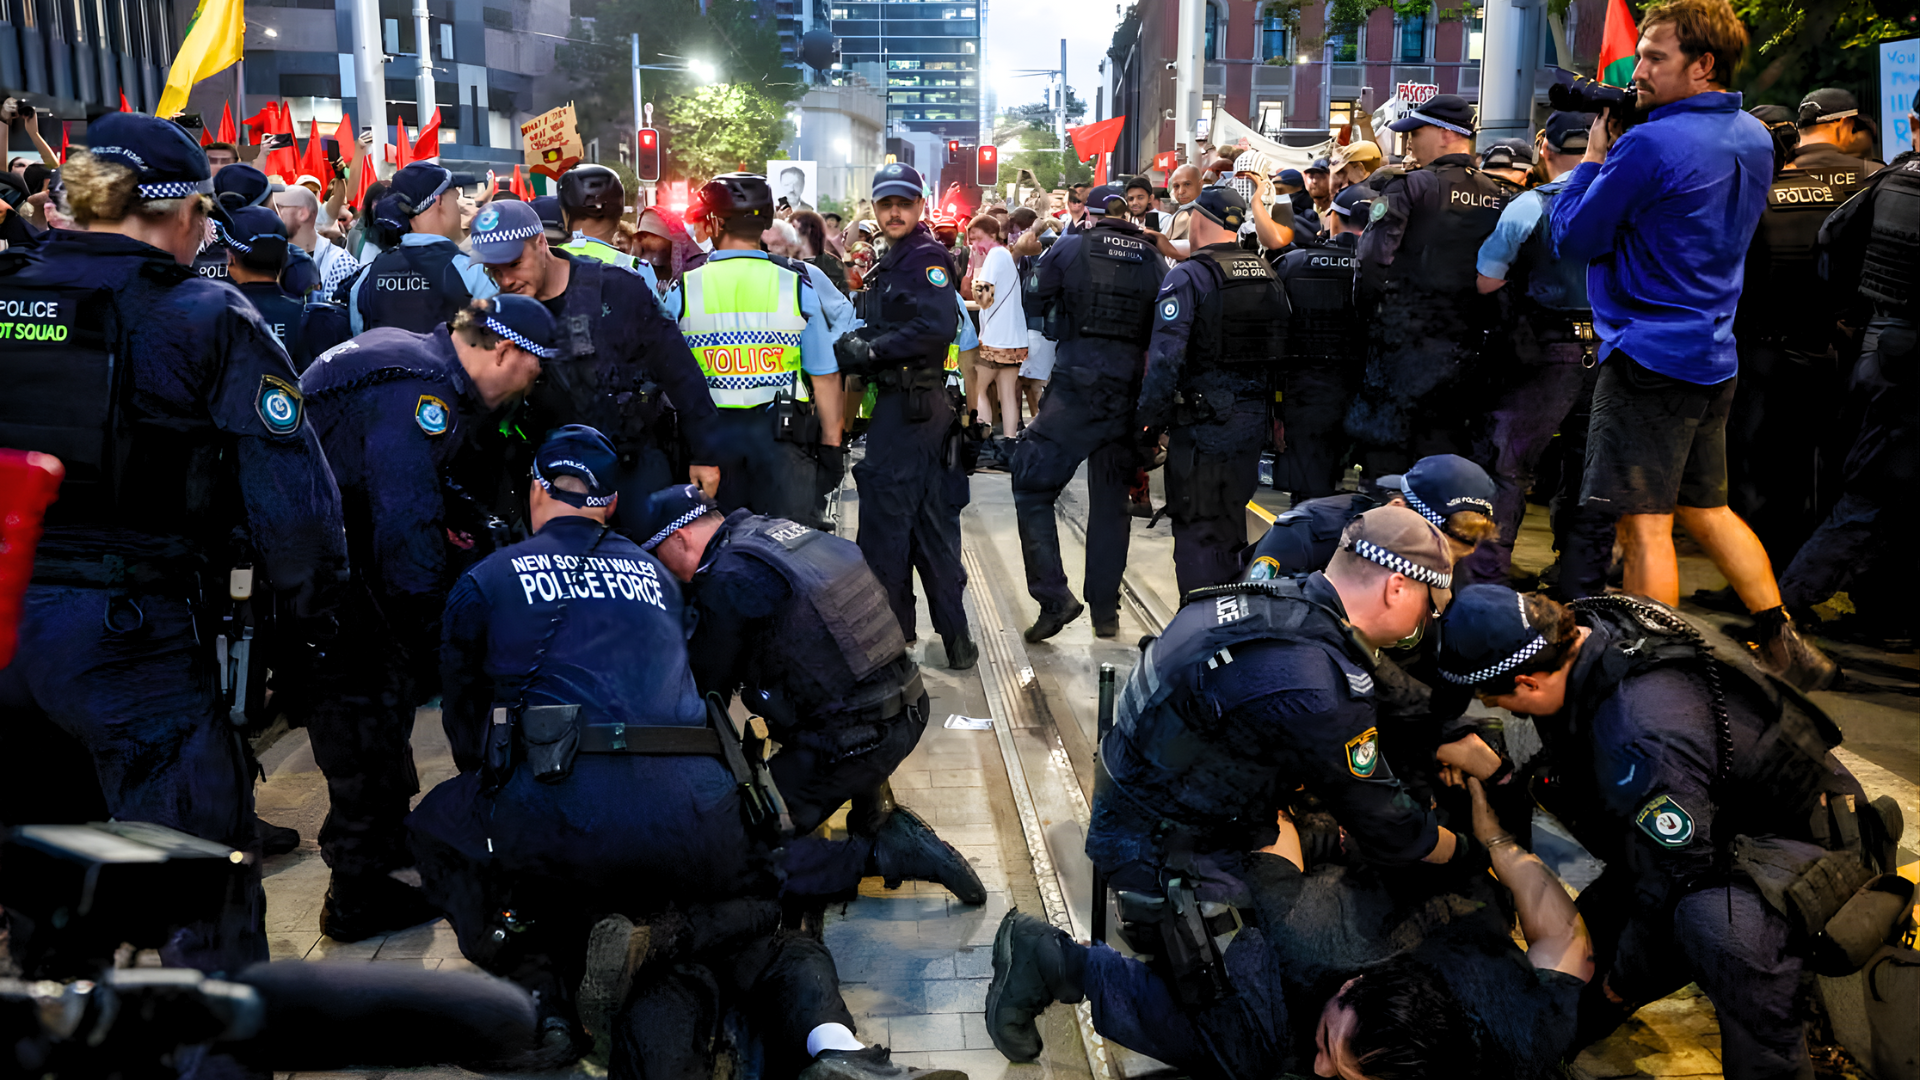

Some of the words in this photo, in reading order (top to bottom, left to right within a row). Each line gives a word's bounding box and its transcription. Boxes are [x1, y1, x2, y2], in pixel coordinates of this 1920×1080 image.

[1451, 190, 1500, 210] POLICE
[1773, 187, 1835, 203] POLICE
[1310, 256, 1359, 268] POLIC
[376, 277, 431, 292] POLICE
[14, 323, 68, 341] SQUAD
[511, 554, 551, 573] NEW
[607, 557, 658, 579] WALES
[519, 571, 606, 605] POLICE
[602, 572, 667, 611] FORCE
[1216, 595, 1240, 625] LICE
